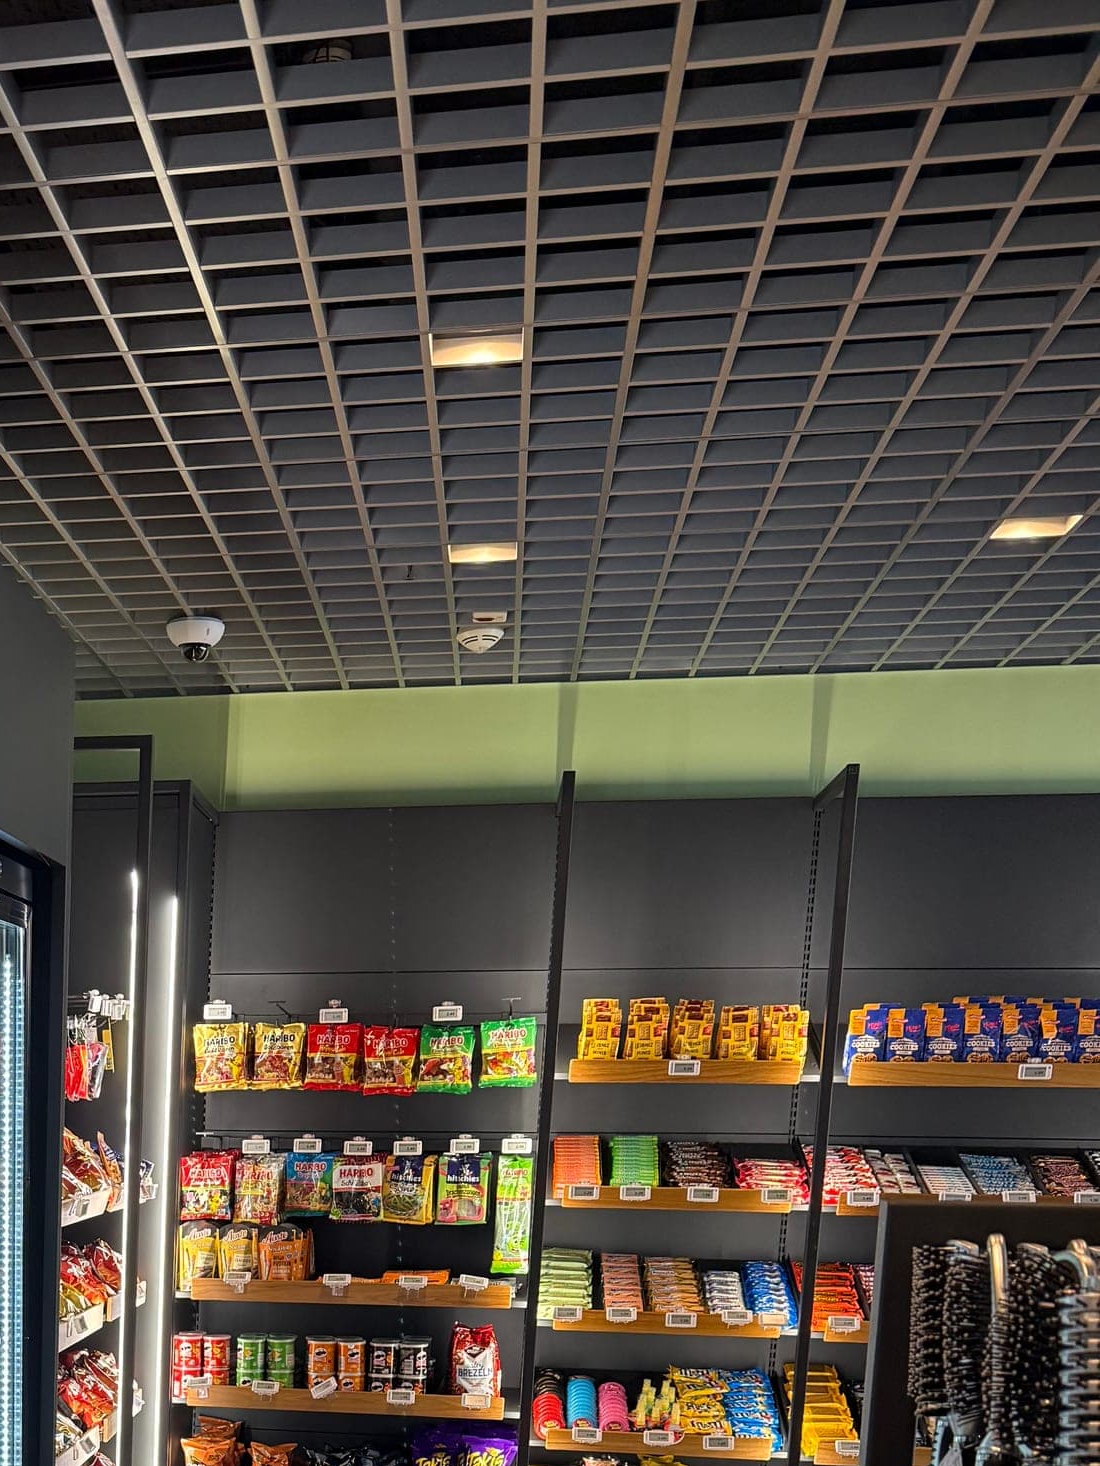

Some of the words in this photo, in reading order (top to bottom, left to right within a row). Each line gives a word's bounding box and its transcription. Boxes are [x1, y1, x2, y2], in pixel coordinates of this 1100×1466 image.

[264, 1033, 295, 1043] HARIBO
[317, 1034, 350, 1045] HARIBO
[491, 1028, 526, 1040] HARIBO
[204, 1035, 235, 1046] HARIBO
[373, 1038, 408, 1049] HARIBO
[340, 1167, 374, 1178] HARIBO
